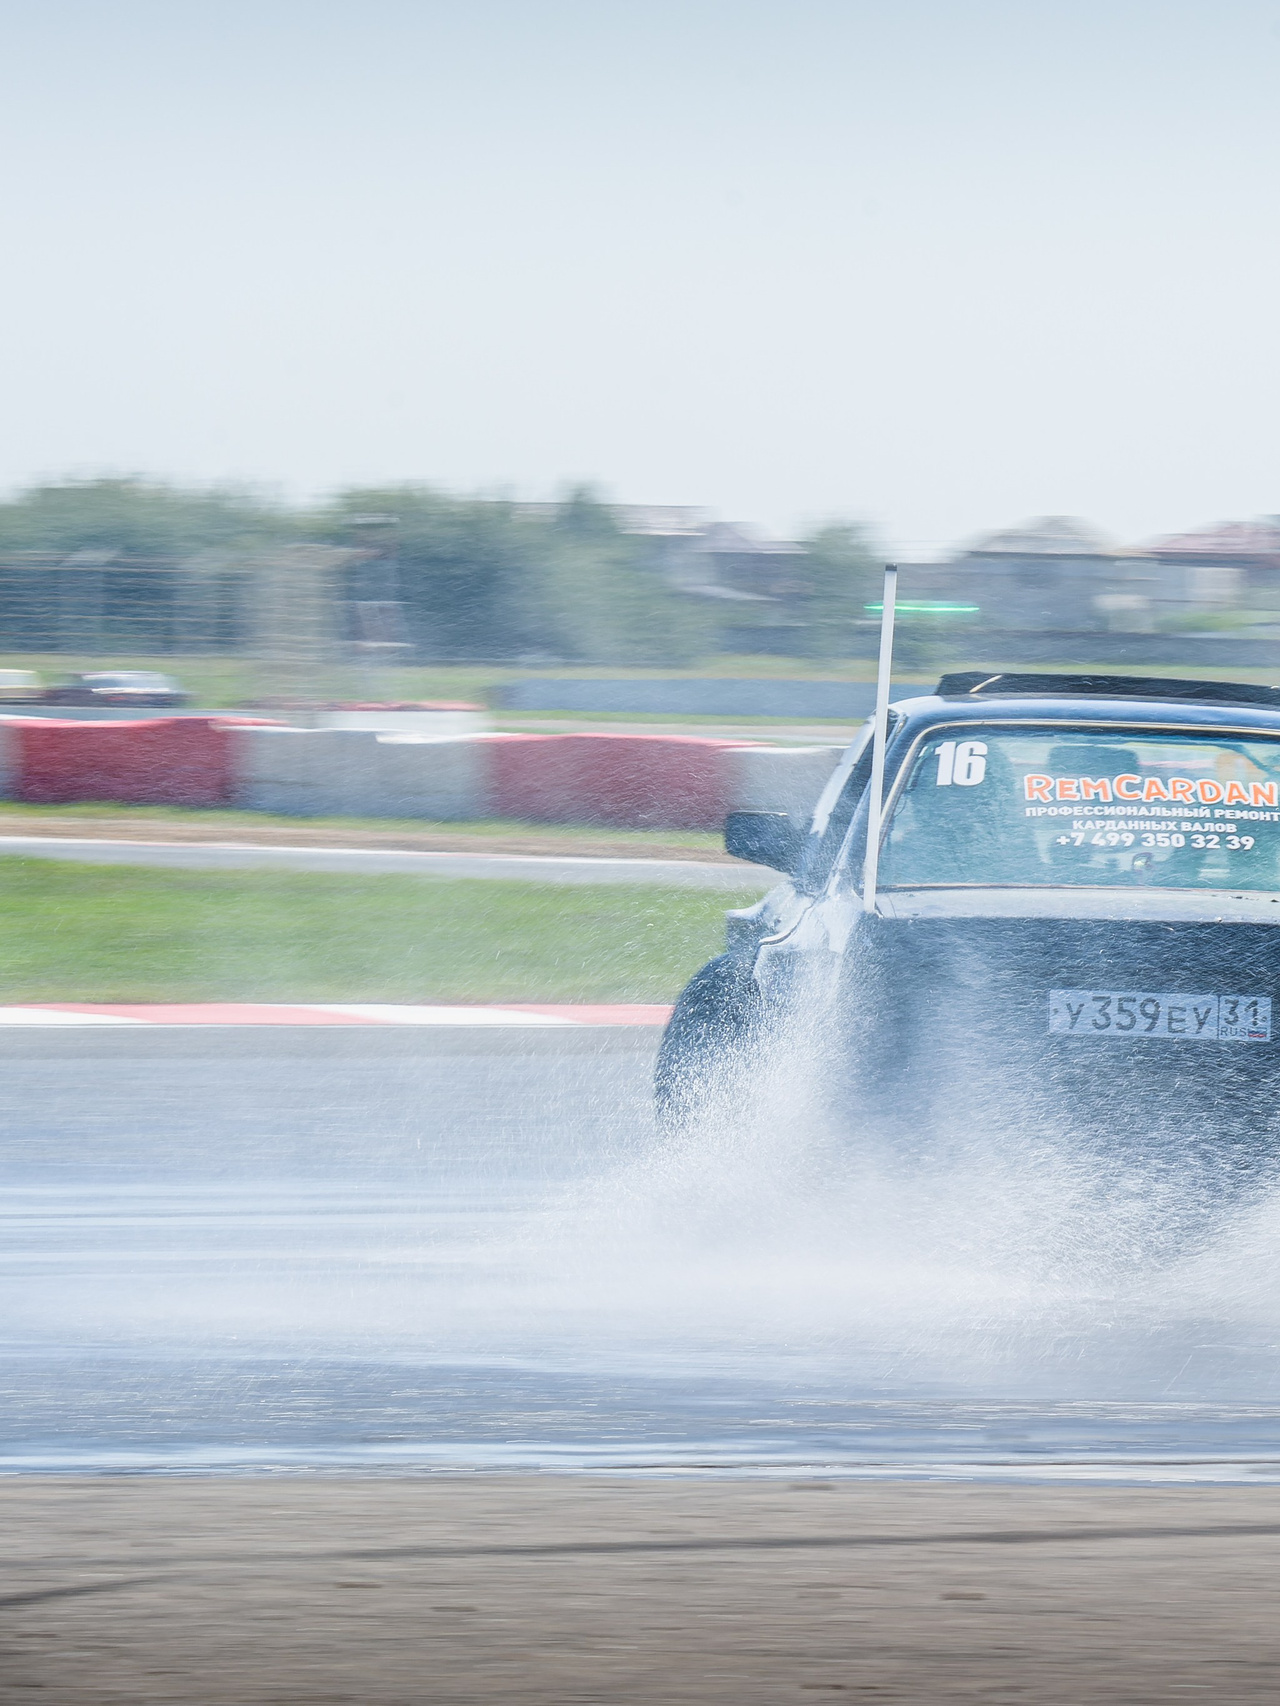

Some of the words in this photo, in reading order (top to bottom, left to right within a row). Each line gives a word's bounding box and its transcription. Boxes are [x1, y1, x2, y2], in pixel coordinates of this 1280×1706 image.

[934, 741, 988, 786] 16
[1025, 806, 1211, 818] ПРОФЕССИОНАЛЬНЫЙ
[1214, 809, 1280, 821] РЕМОНТ
[1072, 820, 1178, 832] КАРДАННЫХ
[1181, 821, 1238, 833] ВАЛОВ
[1056, 833, 1085, 847] +7
[1091, 833, 1134, 847] 499
[1140, 833, 1186, 848] 350
[1190, 834, 1221, 849] 32
[1225, 835, 1255, 851] 39
